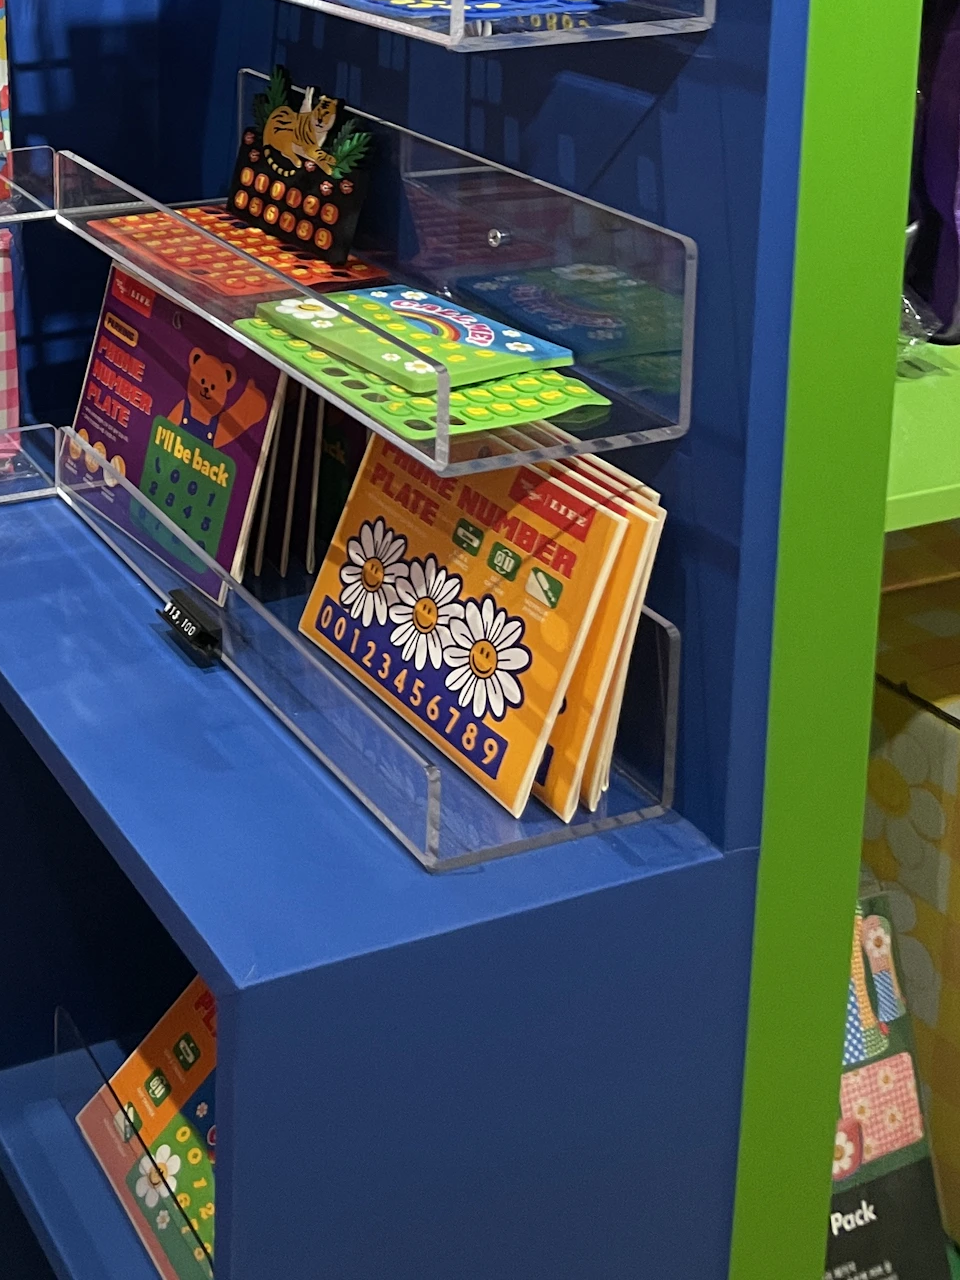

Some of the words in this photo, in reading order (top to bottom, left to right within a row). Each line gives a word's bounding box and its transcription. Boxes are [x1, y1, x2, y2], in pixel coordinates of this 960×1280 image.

[97, 335, 146, 382] PHONE
[86, 381, 130, 428] PLATE
[92, 358, 153, 415] NUMBER
[155, 425, 175, 453] I'll
[173, 435, 192, 464] be
[192, 447, 229, 488] back
[369, 462, 440, 527] PLATE
[549, 498, 589, 527] LIFE
[456, 484, 577, 580] NUMBER
[830, 1199, 878, 1236] Pack
